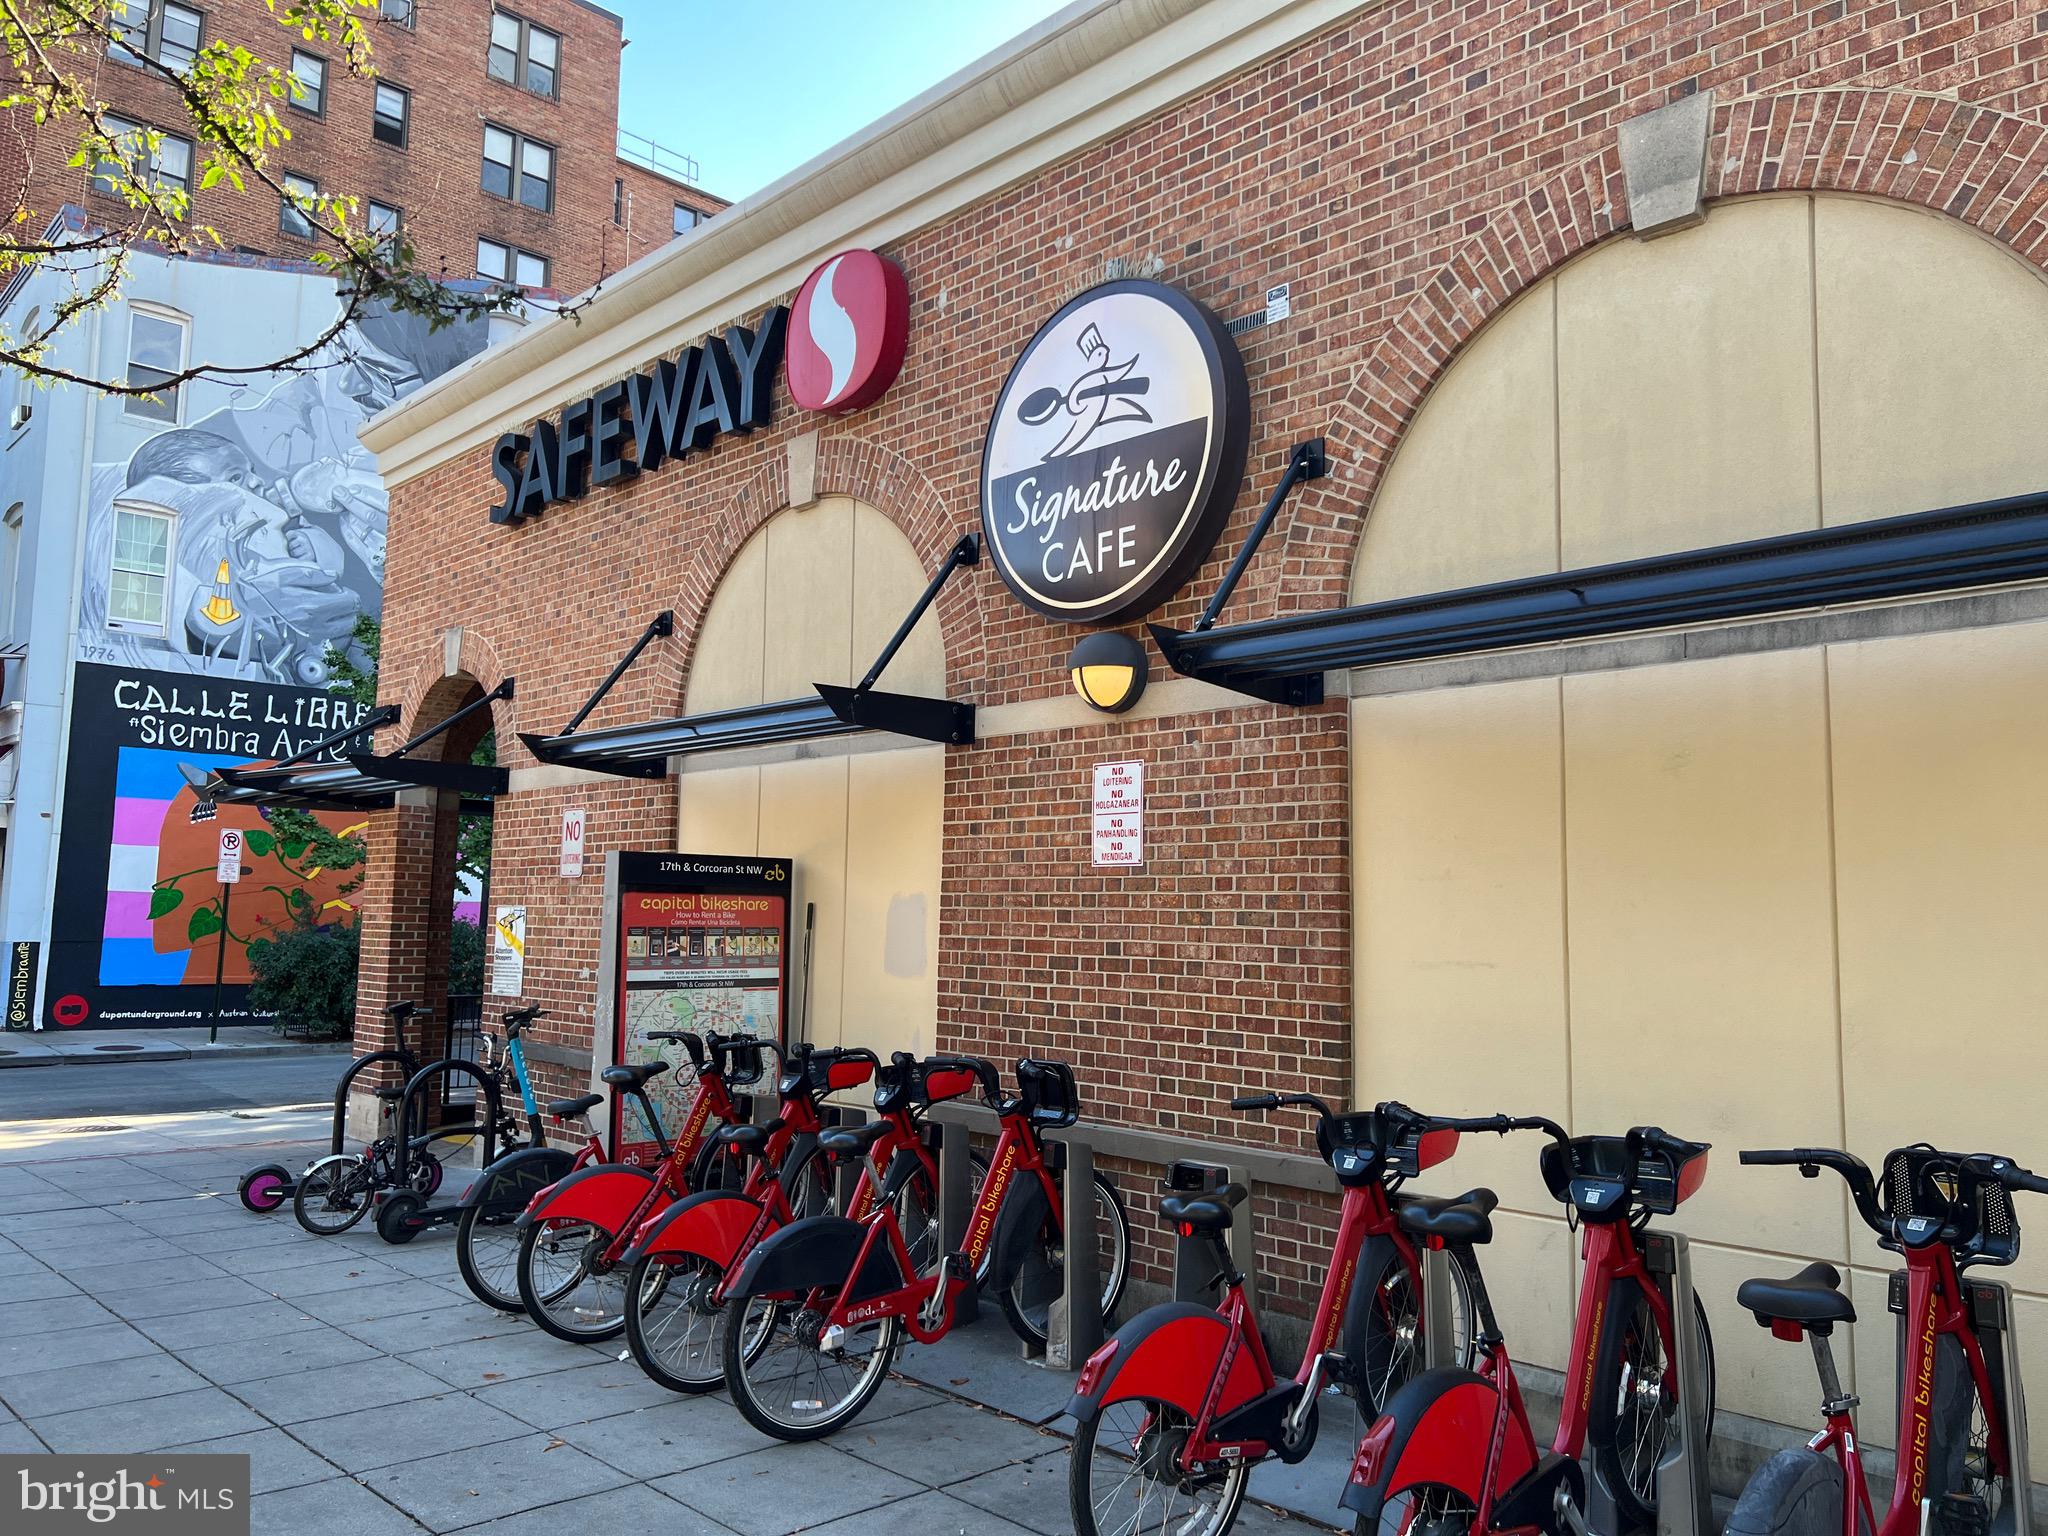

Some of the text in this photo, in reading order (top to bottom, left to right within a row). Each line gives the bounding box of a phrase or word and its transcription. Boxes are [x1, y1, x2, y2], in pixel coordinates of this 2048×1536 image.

[489, 305, 790, 526] SAFEWAY
[1007, 455, 1188, 544] Signature
[1041, 525, 1137, 584] CAFE
[113, 679, 252, 721] CALLE
[140, 715, 259, 755] Siembra
[1111, 767, 1124, 776] NO
[1103, 776, 1133, 787] LOITERING
[1095, 798, 1139, 809] HOLGAZANEAR
[1111, 790, 1124, 798] NO
[565, 821, 581, 842] NO
[1110, 819, 1123, 828] NO
[1096, 829, 1138, 839] PANHANDLING
[1110, 842, 1123, 850] NO
[1101, 852, 1133, 861] MENDIGAR
[660, 862, 681, 872] 17th
[684, 862, 691, 872] &
[693, 863, 734, 874] Corcoran
[735, 865, 744, 874] St
[747, 866, 763, 875] NW
[640, 894, 769, 913] capital bikeshare
[99, 1009, 202, 1020] dupontunderground.org
[679, 1097, 711, 1148] bikeshare
[981, 1145, 1016, 1212] bikeshare
[1581, 1362, 1593, 1411] capital
[1911, 1292, 1937, 1506] capital bikeshare
